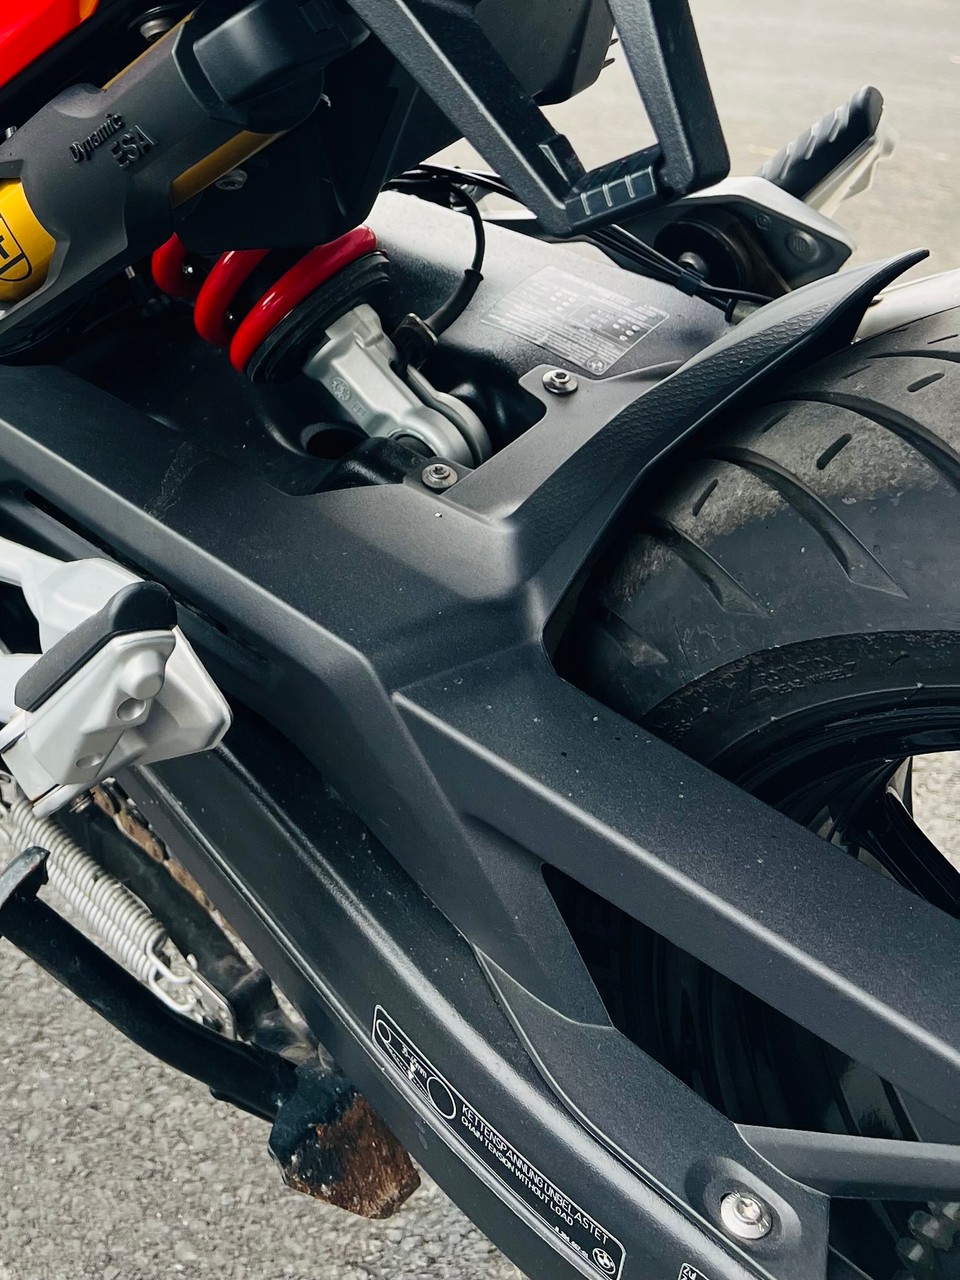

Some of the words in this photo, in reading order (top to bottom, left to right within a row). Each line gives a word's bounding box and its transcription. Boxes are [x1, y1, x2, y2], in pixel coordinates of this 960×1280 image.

[69, 113, 124, 163] Dynamic
[111, 124, 156, 168] ESA
[461, 1116, 483, 1142] CHAIN
[484, 1137, 515, 1173] TENSION
[515, 1168, 550, 1204] WITHOUT
[550, 1201, 574, 1226] LOAD
[462, 1104, 544, 1188] KETTENSPANNUNG
[544, 1182, 609, 1245] UNBELASTET
